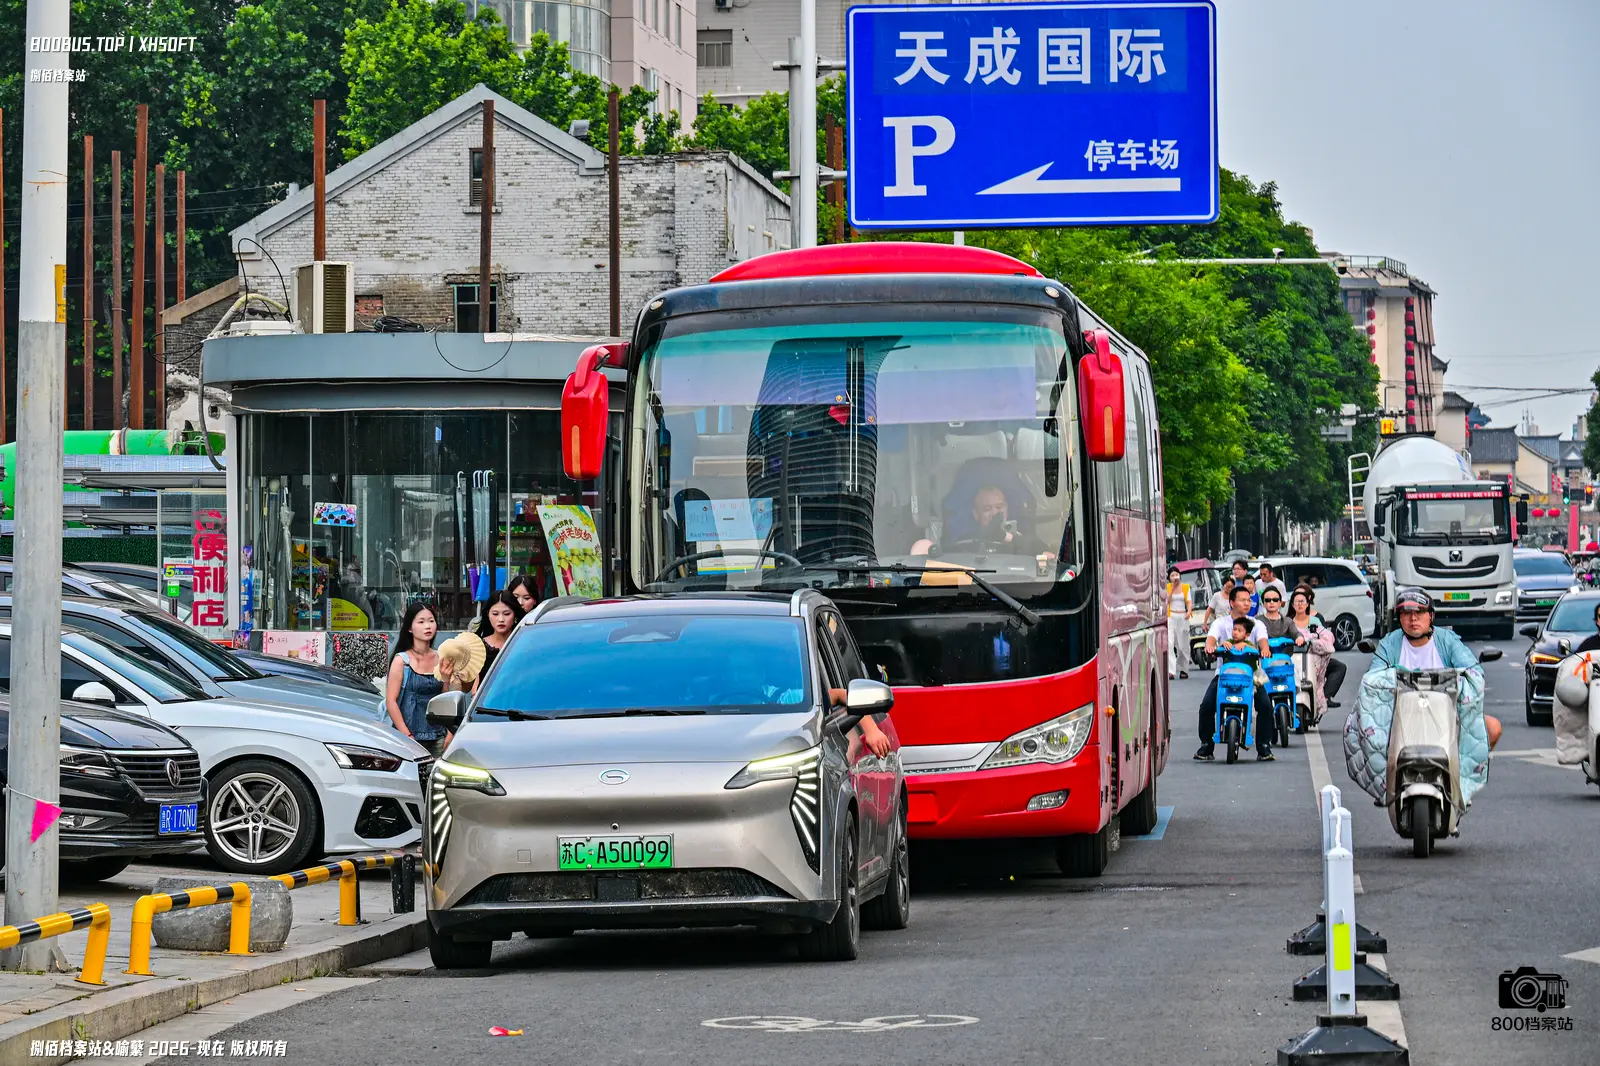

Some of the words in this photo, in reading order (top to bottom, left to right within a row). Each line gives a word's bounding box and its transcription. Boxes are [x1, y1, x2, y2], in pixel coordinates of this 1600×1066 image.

[894, 26, 1167, 86] 天成国际
[883, 115, 956, 198] P
[1083, 138, 1180, 172] 停车场
[192, 532, 226, 627] 便利店
